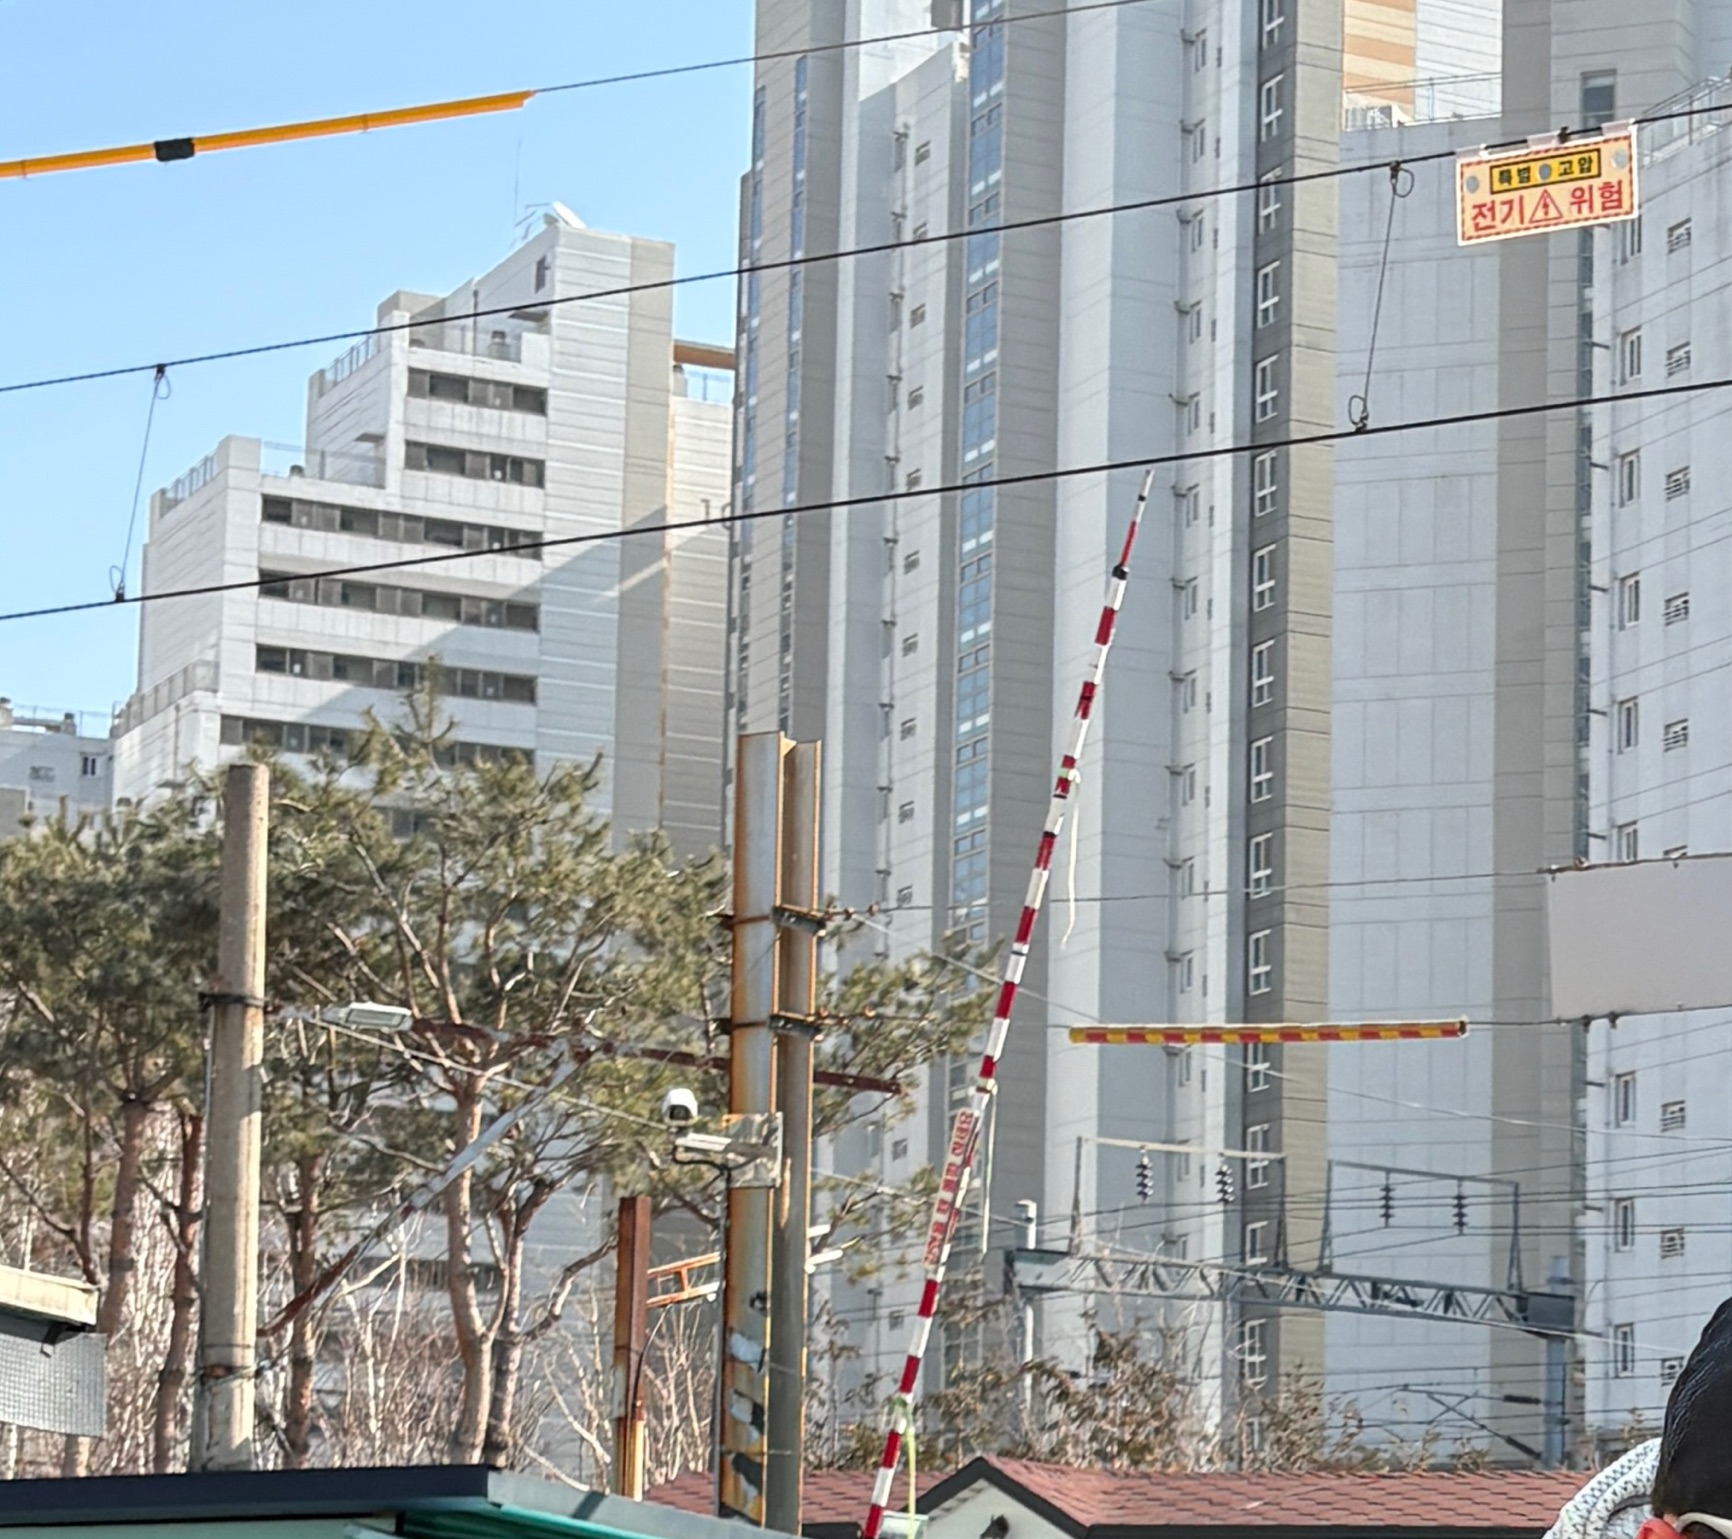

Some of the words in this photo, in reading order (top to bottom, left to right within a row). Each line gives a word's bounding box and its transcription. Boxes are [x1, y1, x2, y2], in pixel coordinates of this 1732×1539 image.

[1498, 165, 1531, 186] 특별
[1558, 155, 1593, 177] 고압
[1471, 194, 1525, 233] 전기
[1570, 179, 1623, 215] 위험
